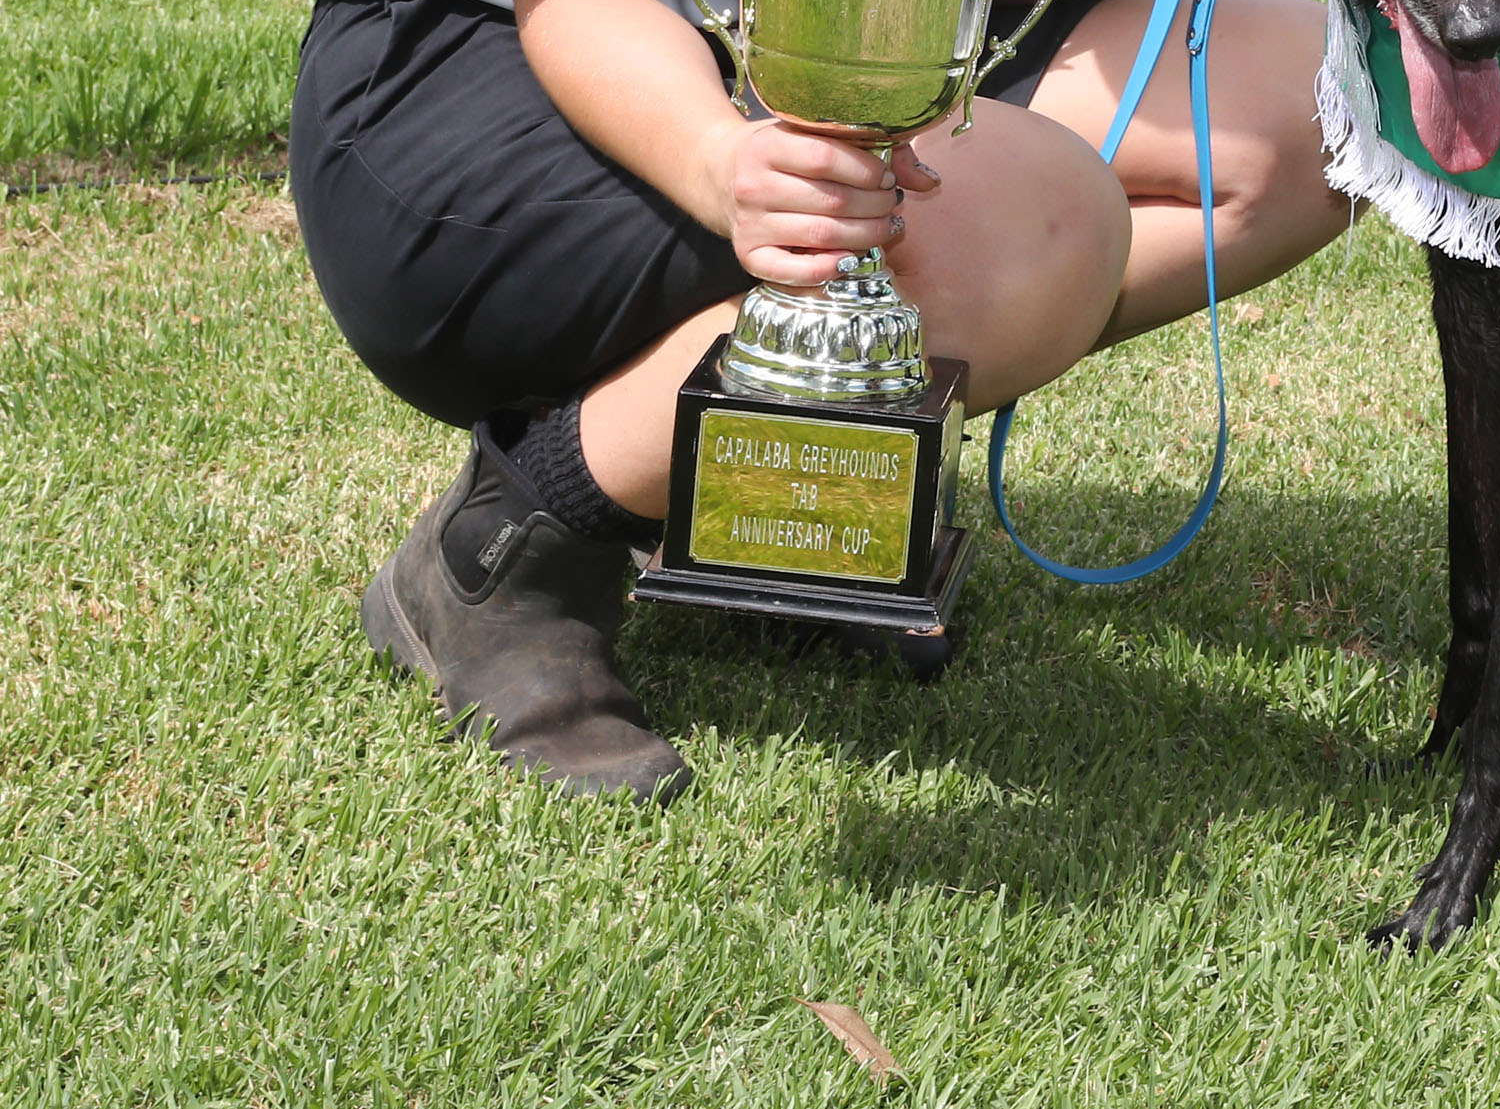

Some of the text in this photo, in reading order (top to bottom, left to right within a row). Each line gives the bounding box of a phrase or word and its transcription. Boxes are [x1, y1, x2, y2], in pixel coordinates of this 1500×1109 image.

[715, 435, 900, 482] CAPALABA GREYHOUNDS
[791, 482, 818, 512] TAB
[730, 515, 871, 556] ANNIVERSARY CUP
